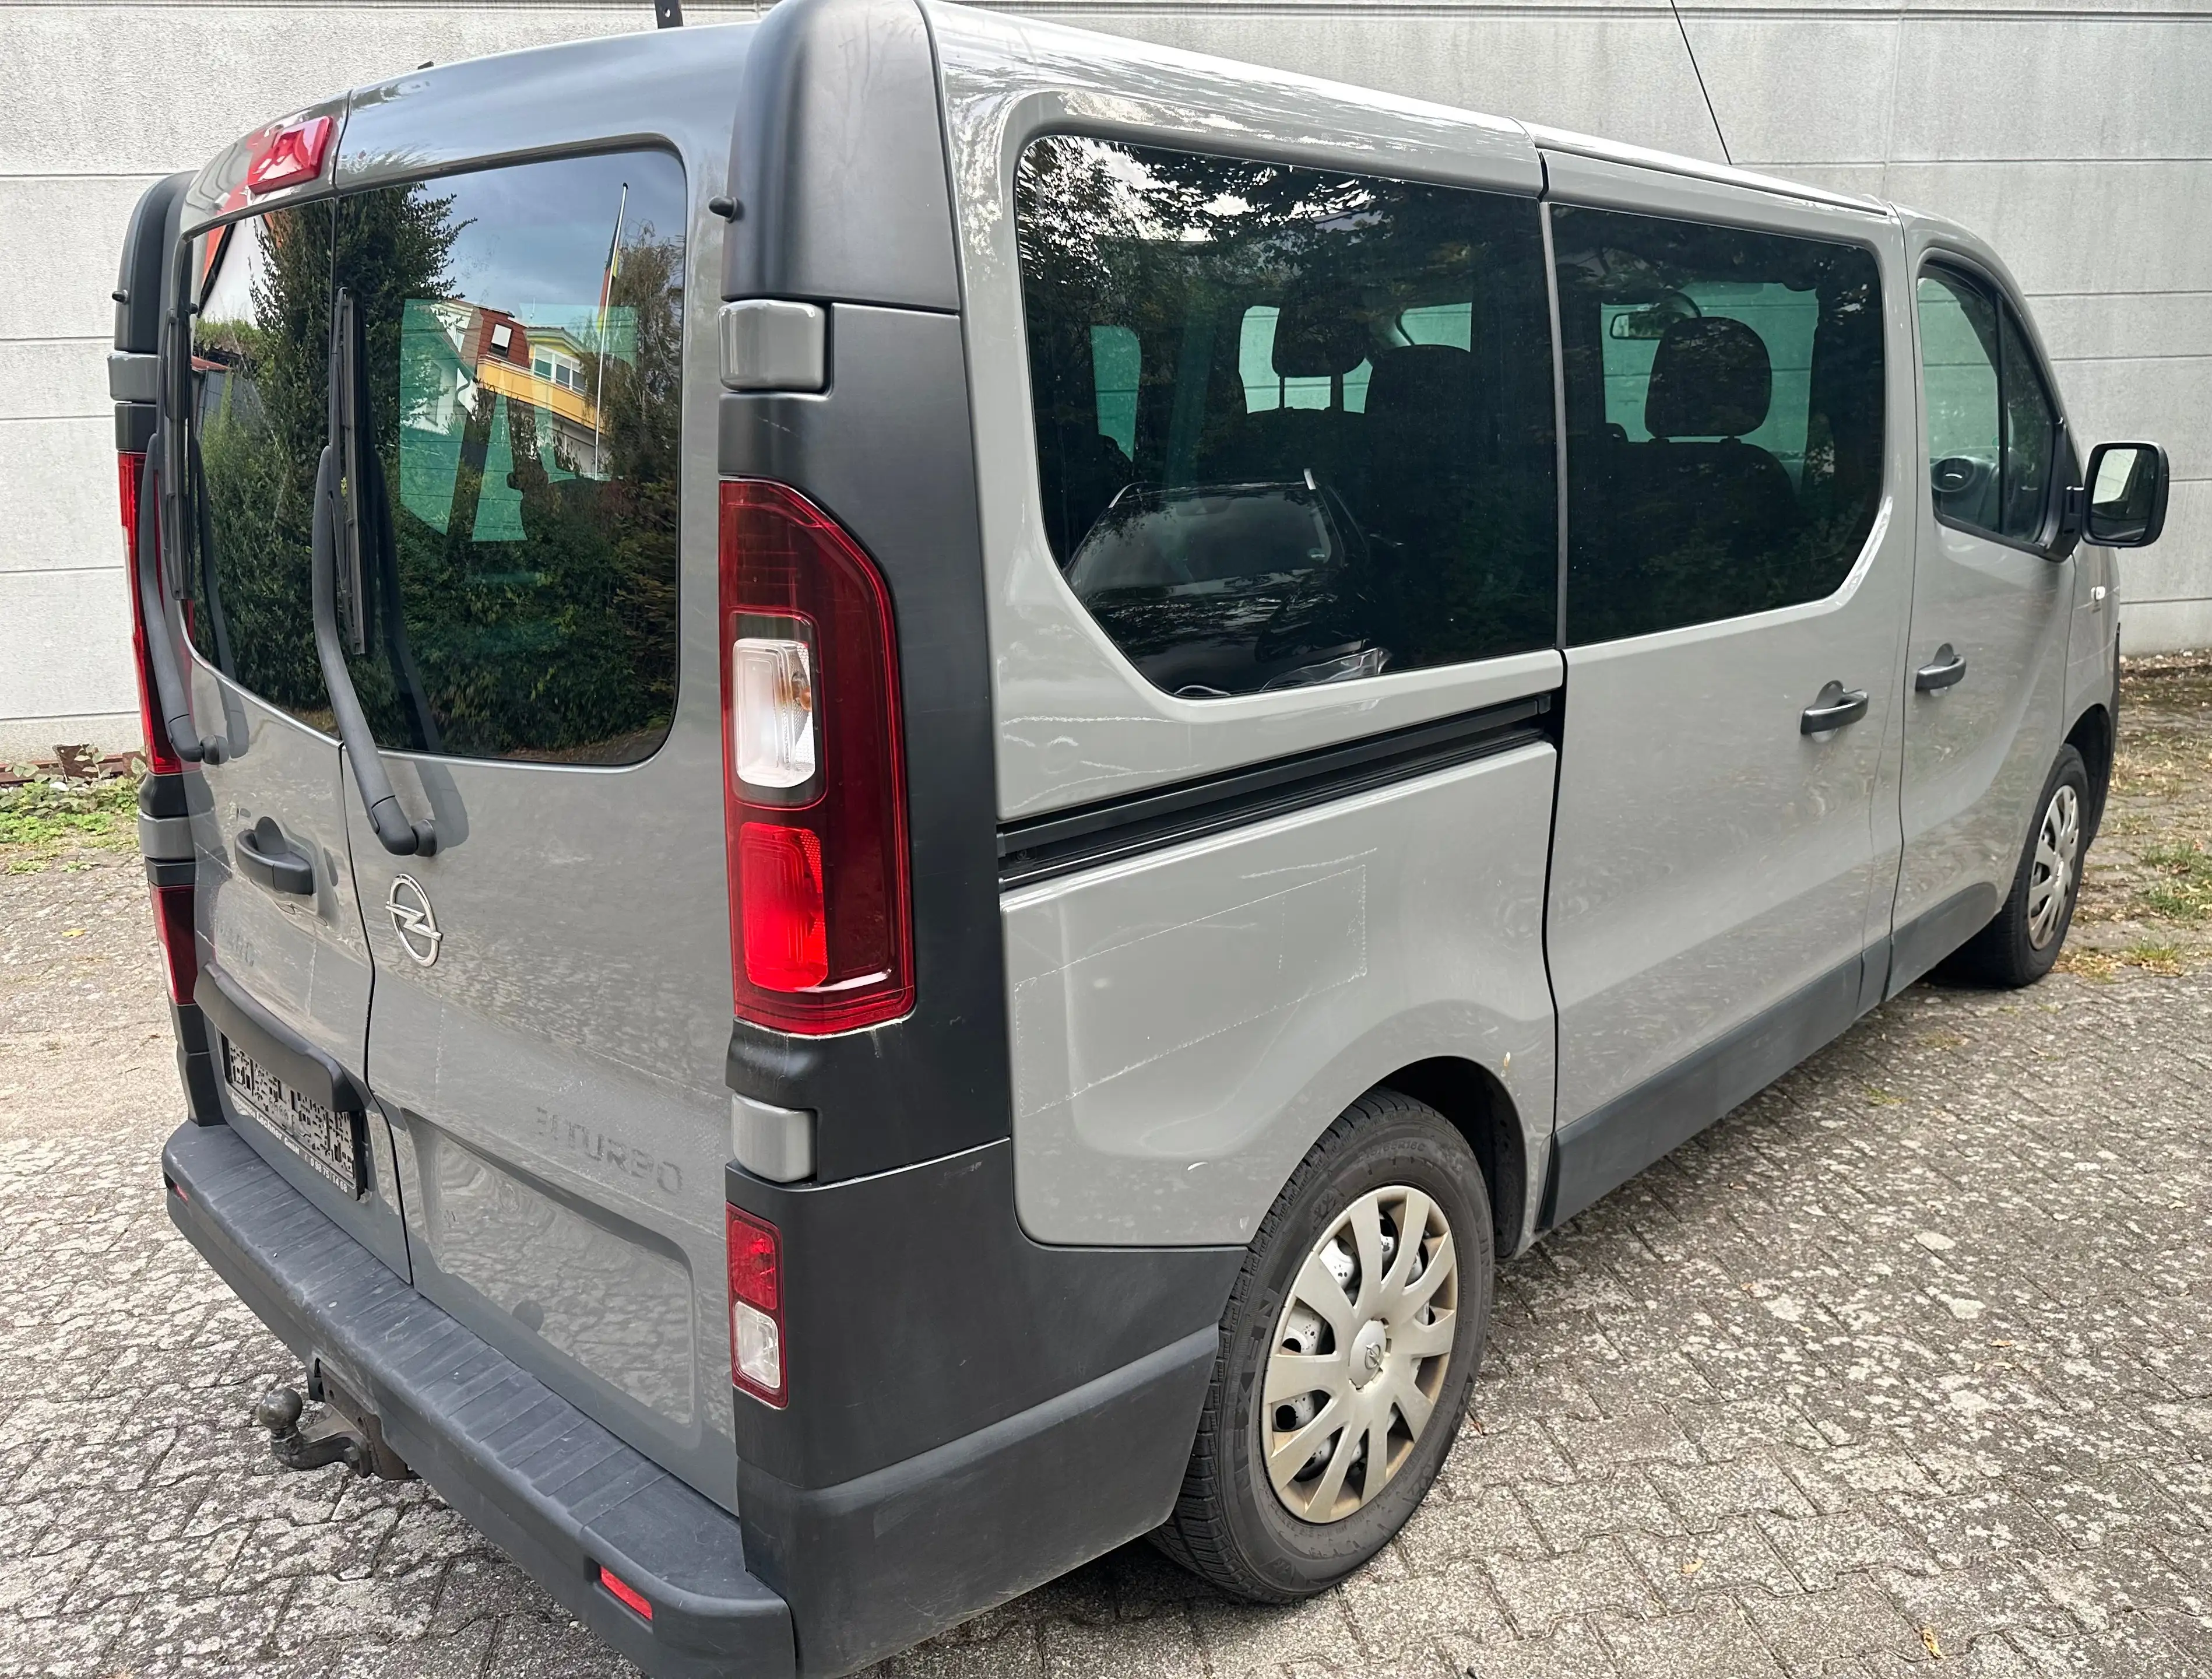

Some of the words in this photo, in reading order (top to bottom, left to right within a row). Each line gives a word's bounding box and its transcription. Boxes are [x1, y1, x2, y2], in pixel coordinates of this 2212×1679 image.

[256, 1110, 283, 1140] Lechner
[284, 1137, 300, 1155] GmbH
[310, 1158, 314, 1167] 0
